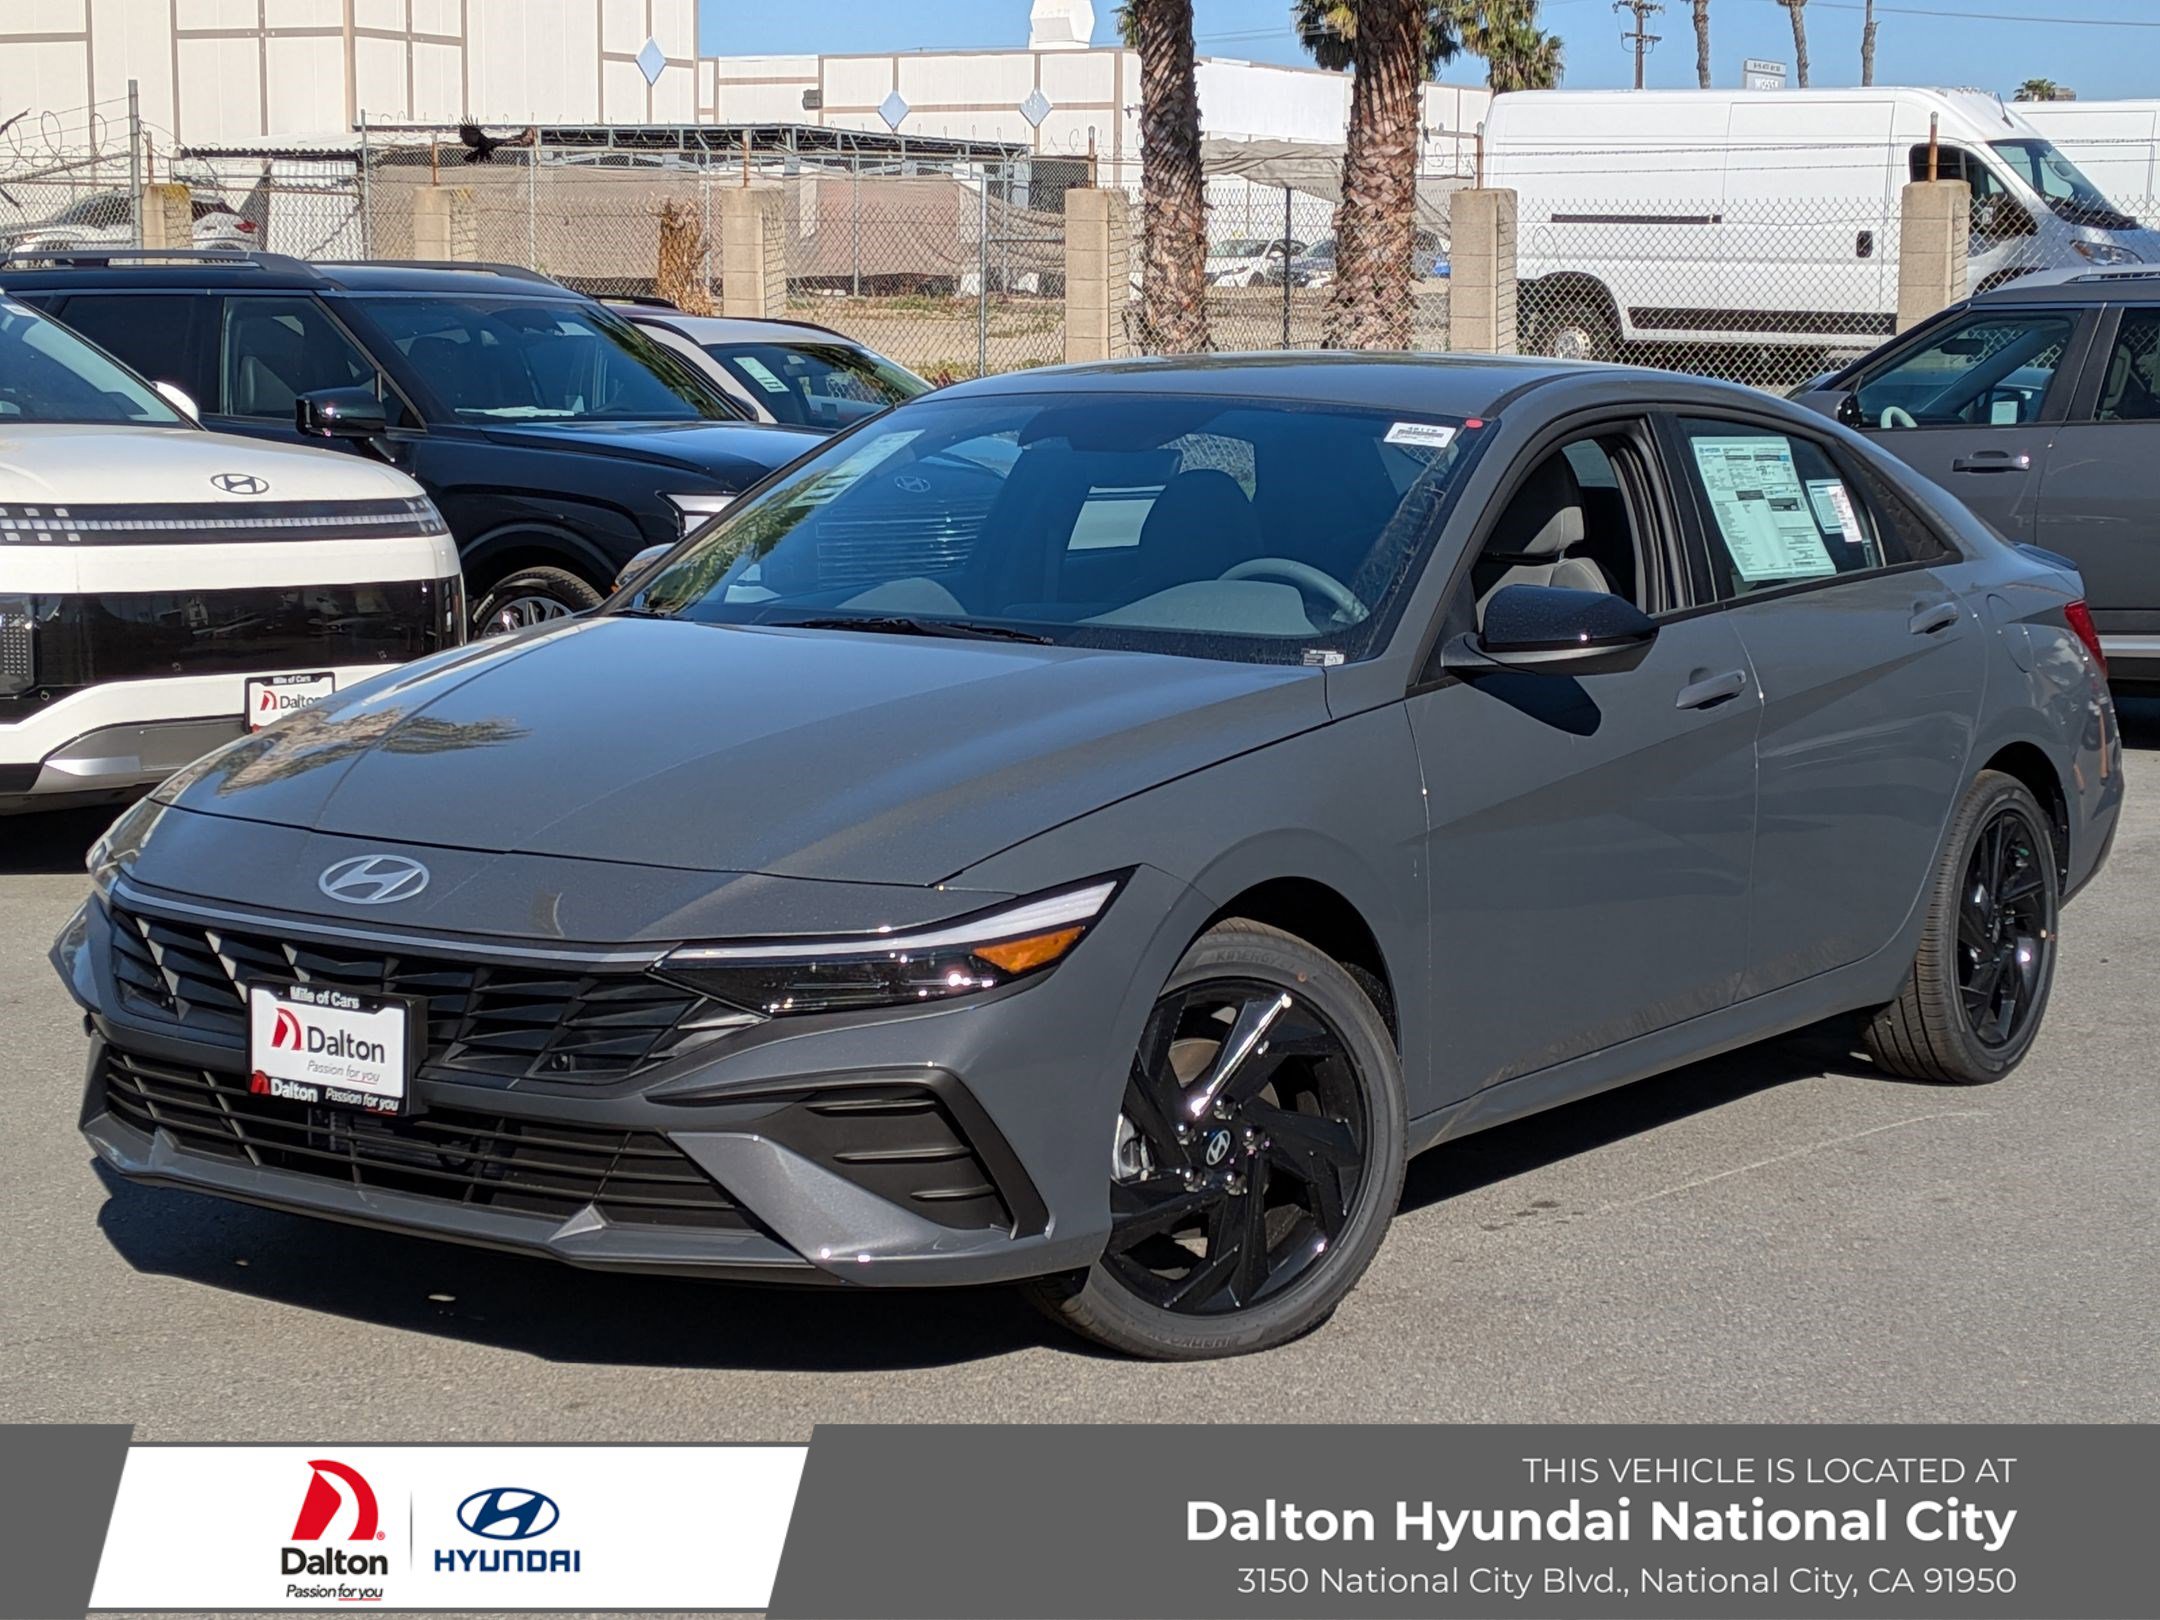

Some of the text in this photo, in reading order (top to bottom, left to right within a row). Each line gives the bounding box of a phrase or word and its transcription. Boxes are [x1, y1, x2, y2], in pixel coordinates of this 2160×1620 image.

[280, 694, 321, 709] Dalto
[290, 986, 360, 1009] Mile of Cars
[307, 1026, 385, 1064] Dalton
[307, 1060, 380, 1083] Passion for you
[270, 1078, 399, 1112] Dalton Passion for you
